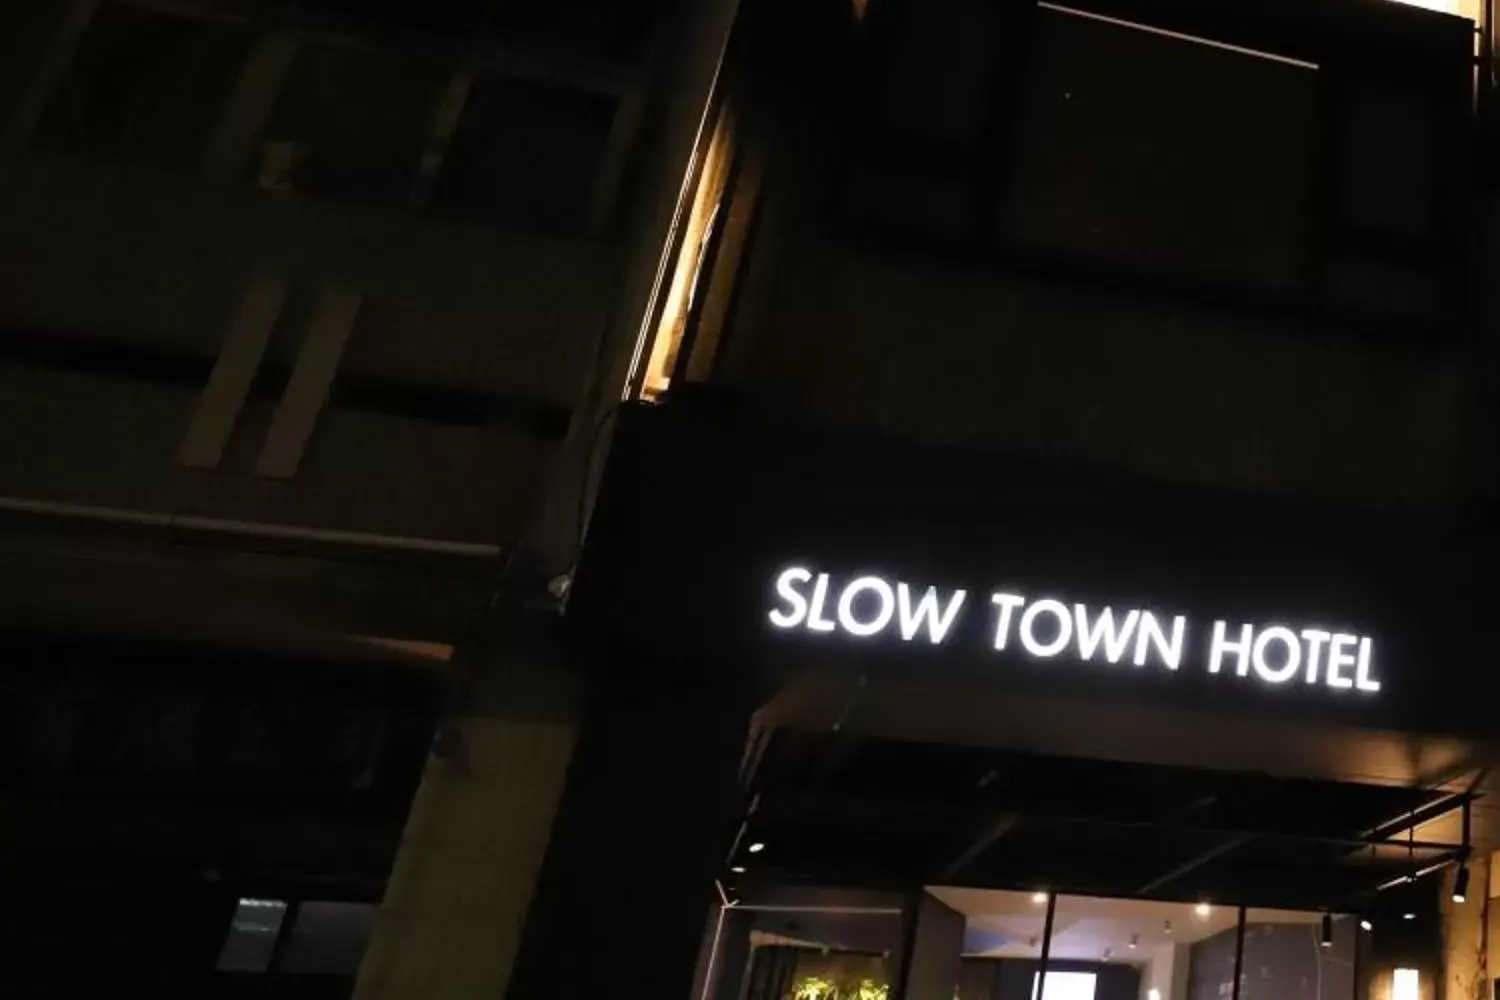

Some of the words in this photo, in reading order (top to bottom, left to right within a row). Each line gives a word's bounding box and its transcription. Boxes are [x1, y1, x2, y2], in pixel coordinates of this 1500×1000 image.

[768, 565, 967, 645] SLOW
[990, 591, 1188, 671] TOWN
[1207, 619, 1381, 693] HOTEL
